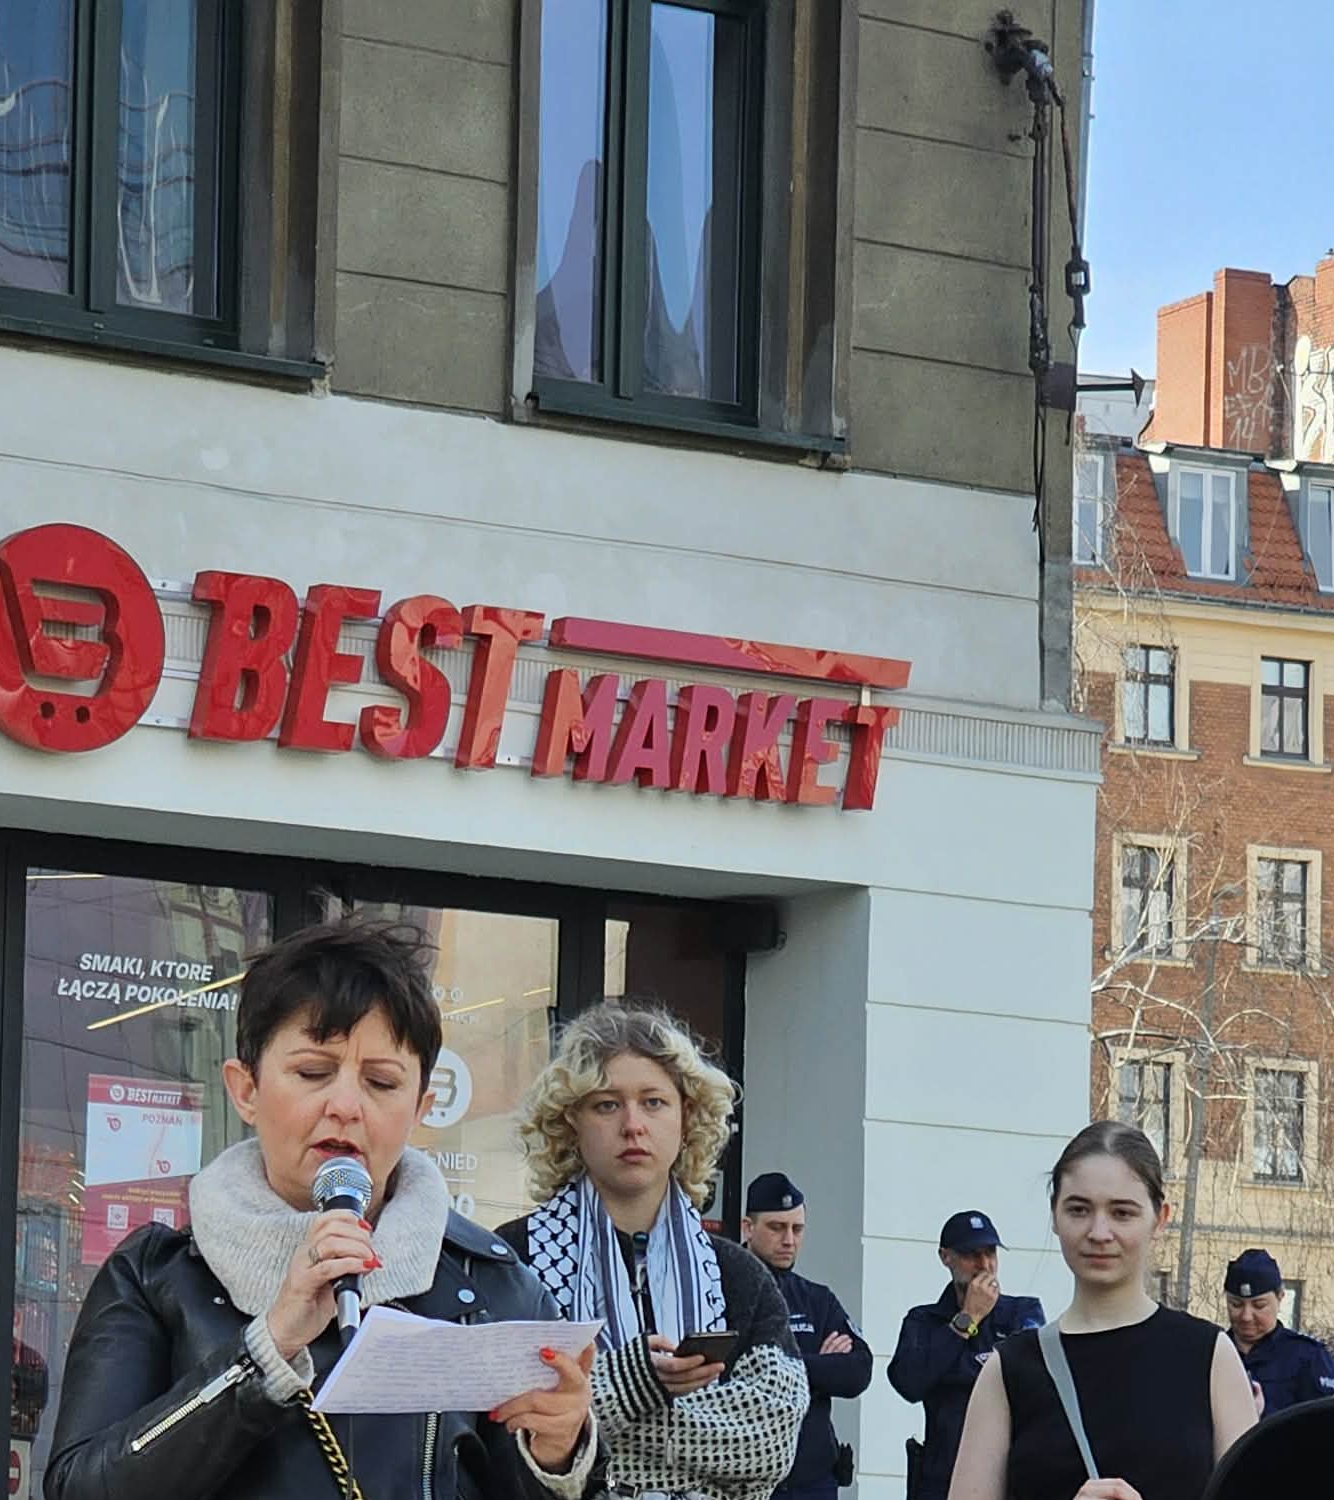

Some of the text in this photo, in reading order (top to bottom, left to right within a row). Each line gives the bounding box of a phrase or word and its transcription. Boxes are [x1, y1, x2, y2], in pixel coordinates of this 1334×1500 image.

[188, 569, 898, 812] BEST MARKET
[79, 953, 146, 979] SMAKI,
[58, 978, 238, 1011] ŁĄCZĄ POKOLENIA!
